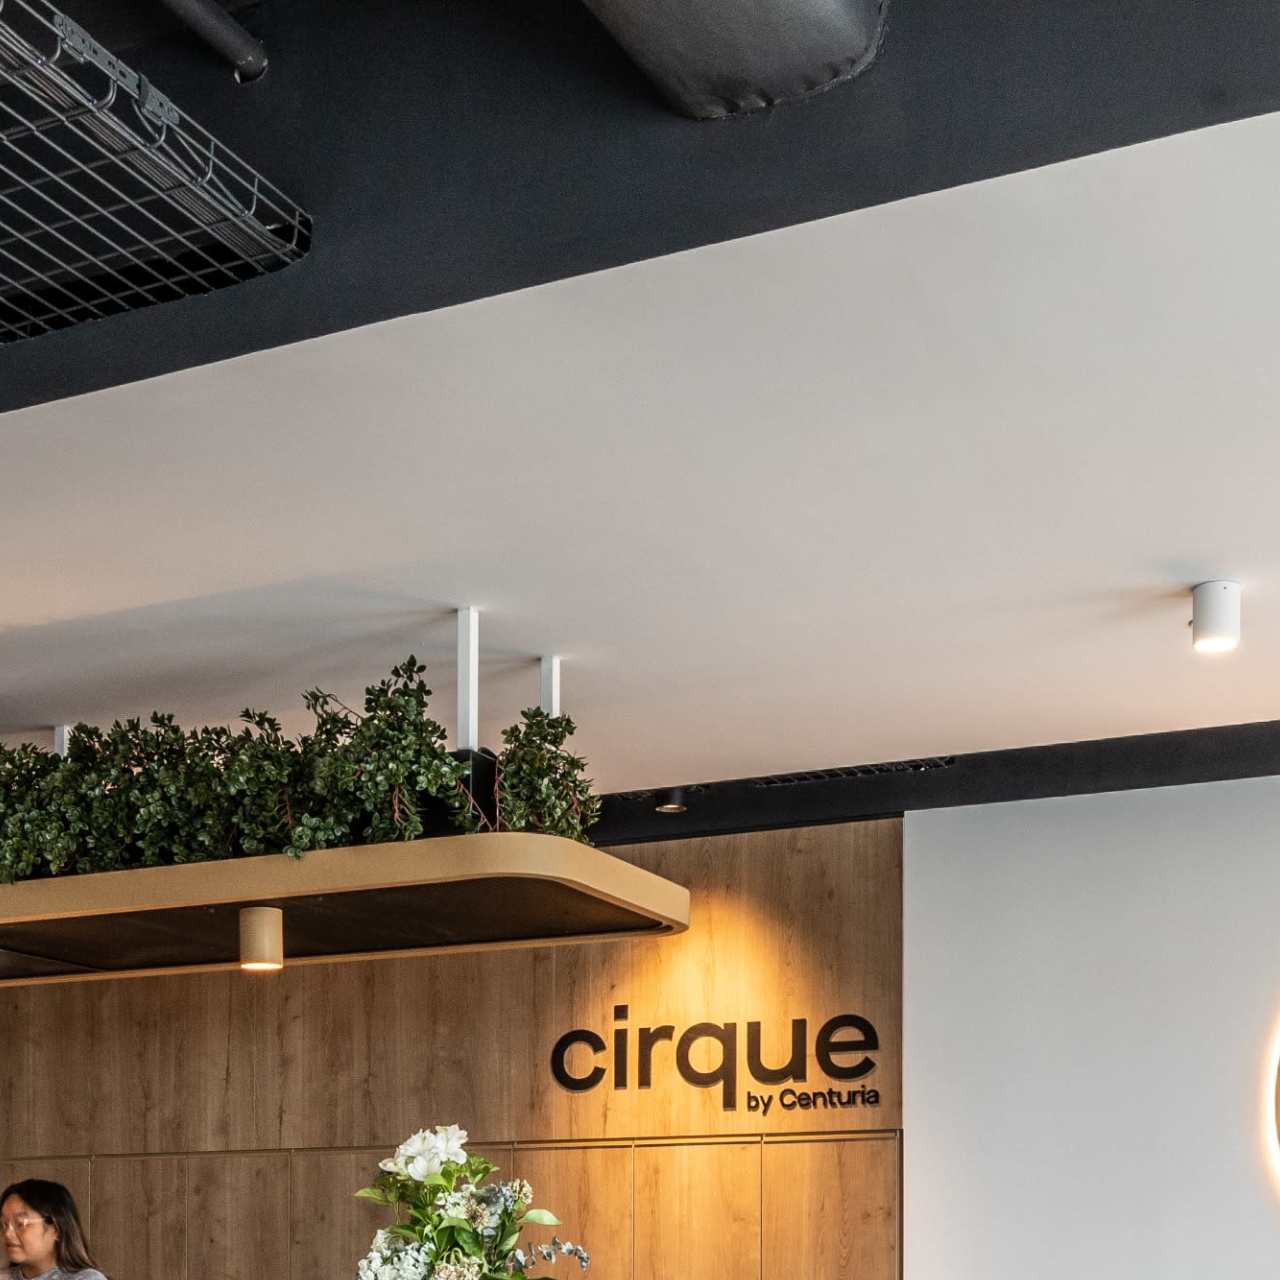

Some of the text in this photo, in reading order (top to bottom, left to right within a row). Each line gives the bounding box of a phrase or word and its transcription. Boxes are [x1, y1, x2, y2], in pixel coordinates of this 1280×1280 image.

[550, 1004, 879, 1111] cirque
[746, 1085, 880, 1115] by Centuria
